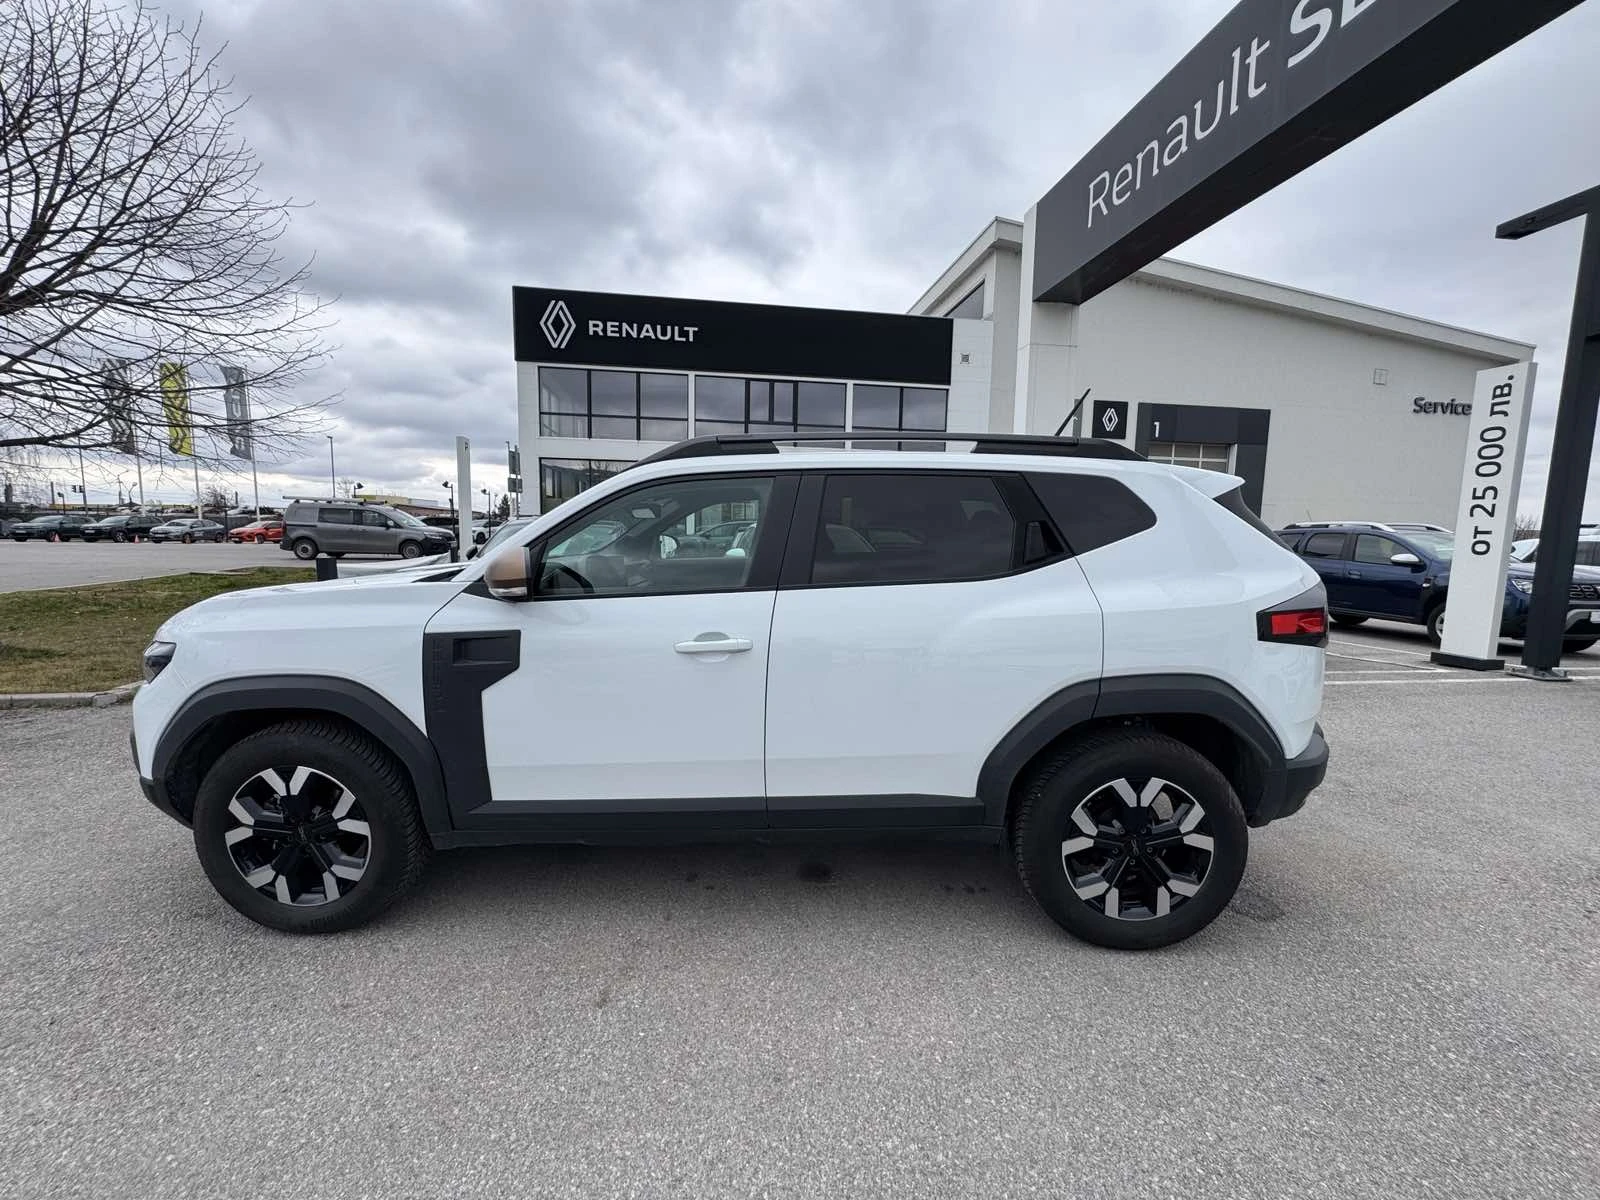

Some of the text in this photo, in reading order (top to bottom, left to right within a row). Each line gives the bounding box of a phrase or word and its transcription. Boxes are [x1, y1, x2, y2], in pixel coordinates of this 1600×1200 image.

[1087, 37, 1271, 229] Renault
[588, 320, 698, 342] RENAULT
[1412, 396, 1473, 416] Service
[1153, 421, 1160, 438] 1
[1469, 374, 1514, 556] от 25 000 лв.
